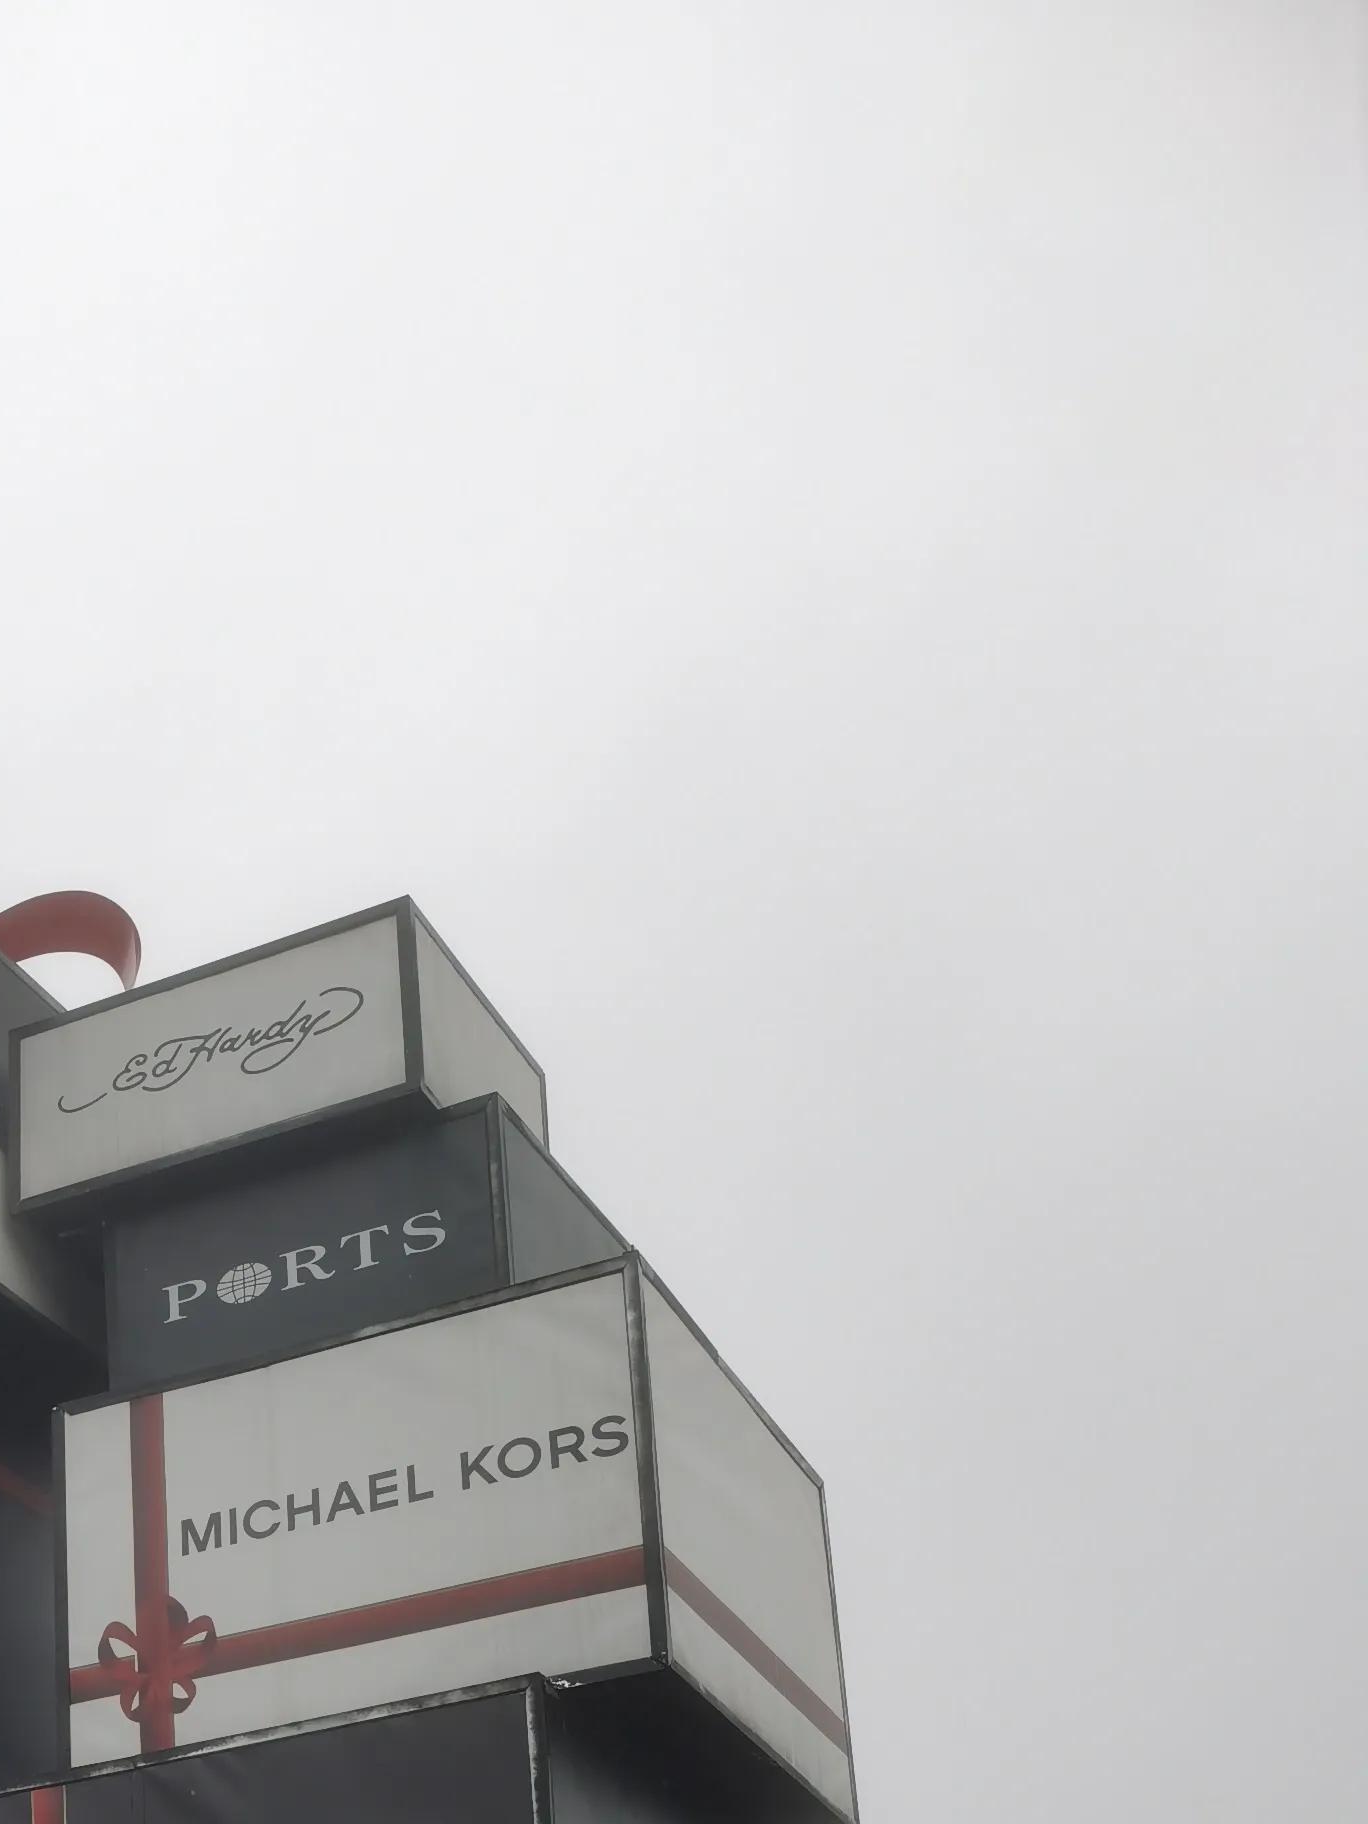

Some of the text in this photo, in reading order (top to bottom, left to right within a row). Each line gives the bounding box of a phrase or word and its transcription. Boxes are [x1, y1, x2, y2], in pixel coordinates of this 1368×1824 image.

[145, 987, 364, 1091] Hardy
[161, 1209, 446, 1324] PORTS
[180, 1415, 630, 1556] MICHAEL KORS
